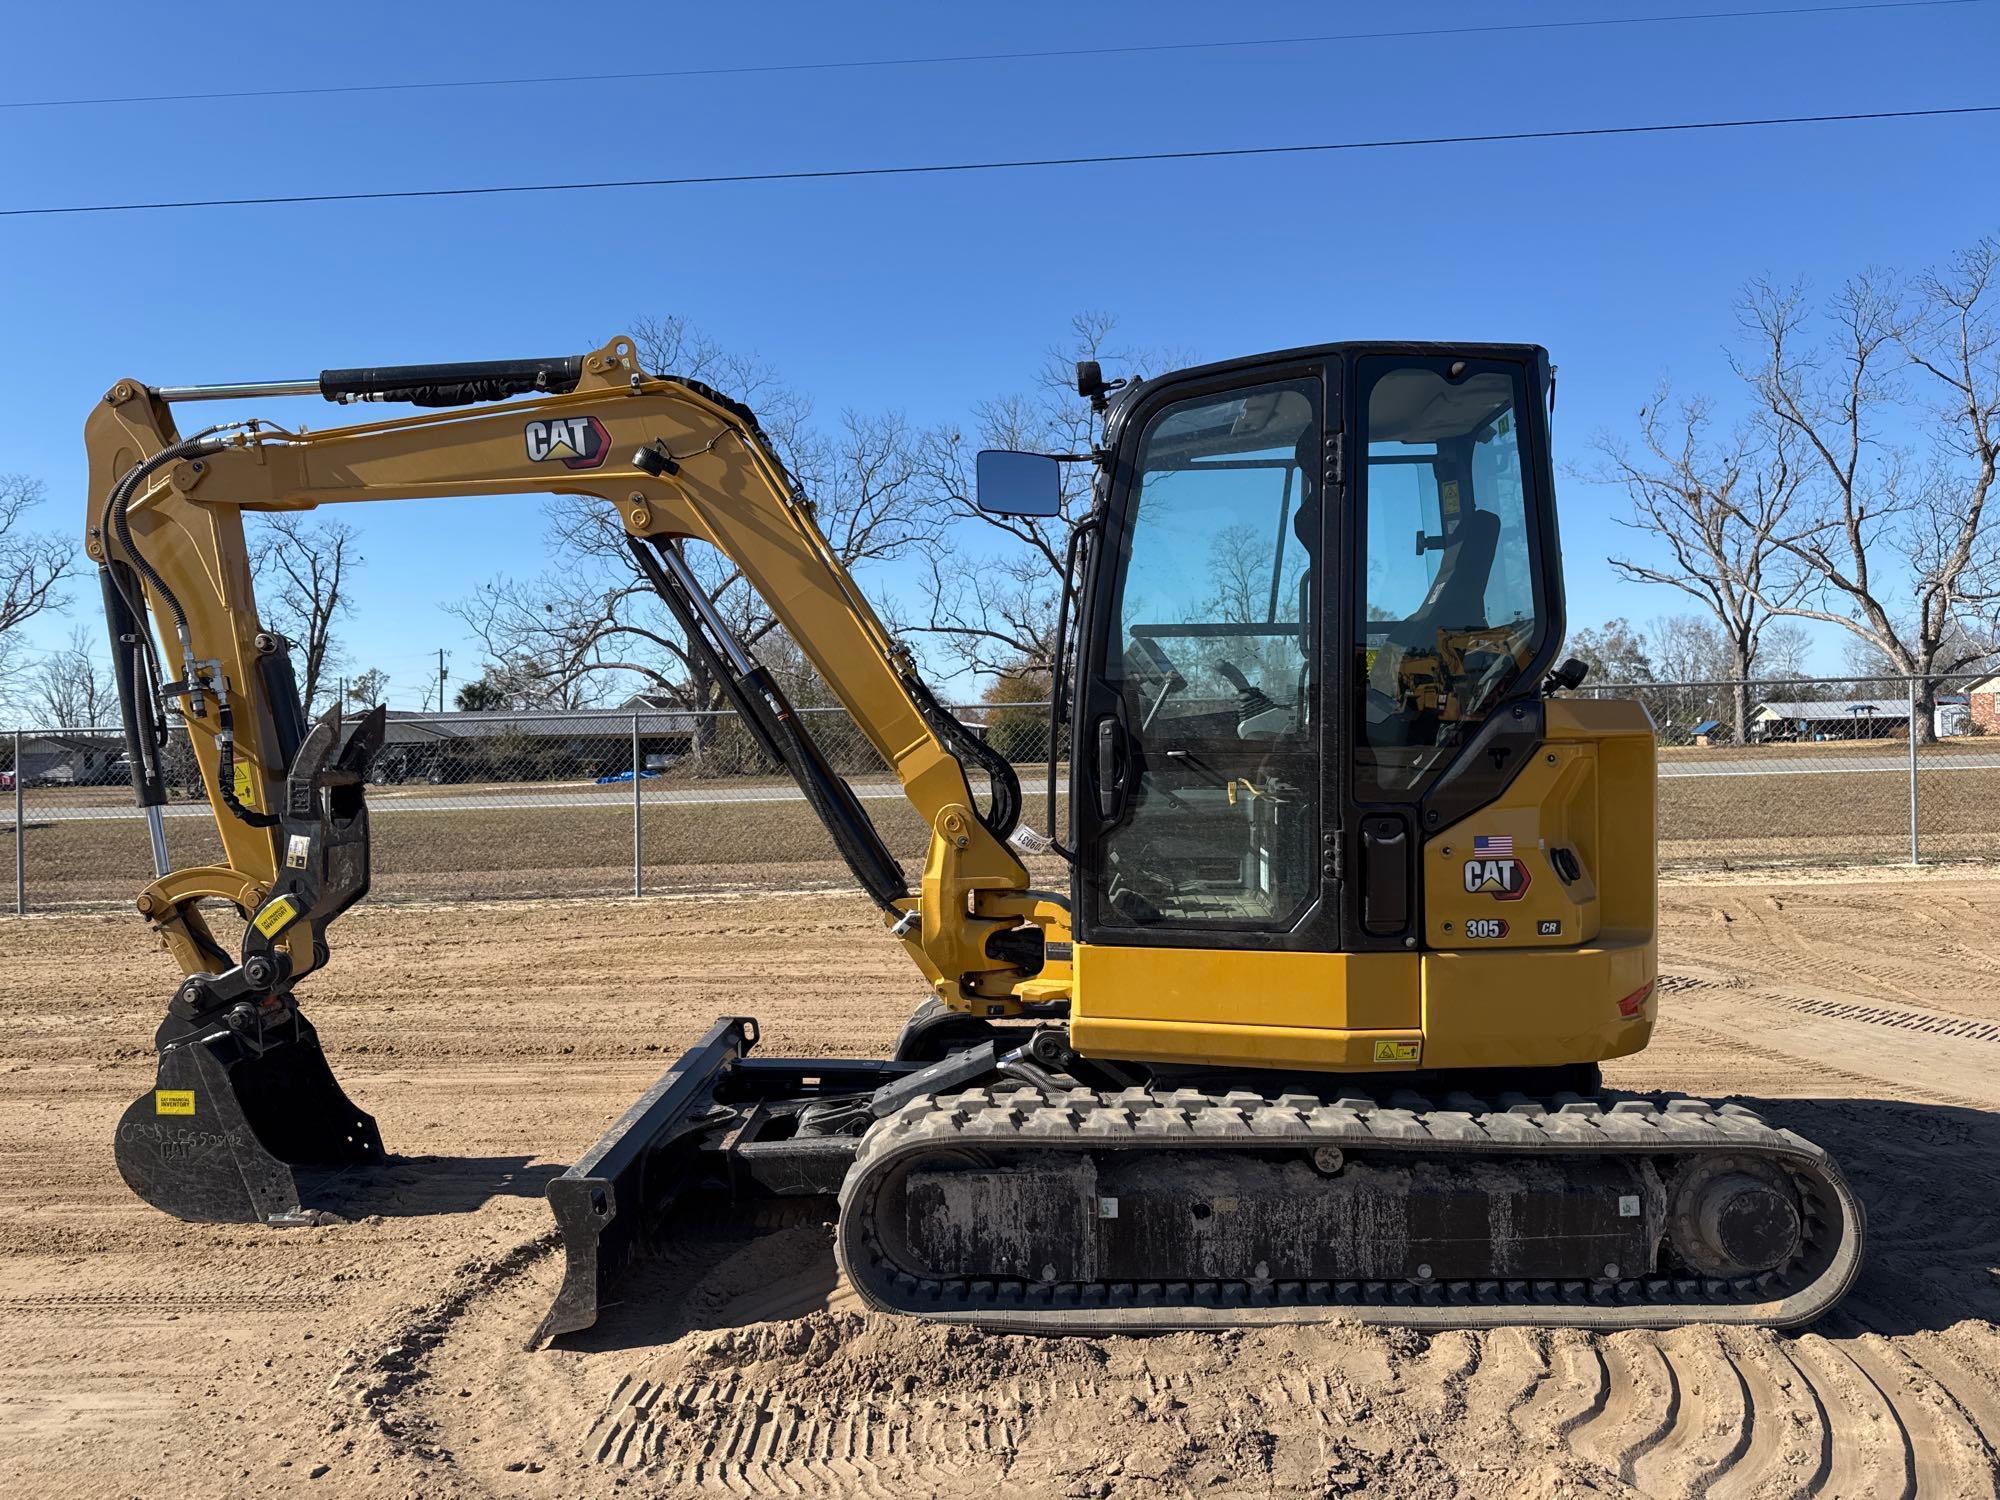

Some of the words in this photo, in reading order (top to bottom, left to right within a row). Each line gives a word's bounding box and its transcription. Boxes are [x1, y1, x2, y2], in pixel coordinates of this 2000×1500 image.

[525, 418, 588, 461] CAT
[1464, 860, 1514, 892] CAT
[264, 908, 289, 931] INVENTORY
[1466, 920, 1500, 938] 305
[1541, 922, 1558, 934] CR
